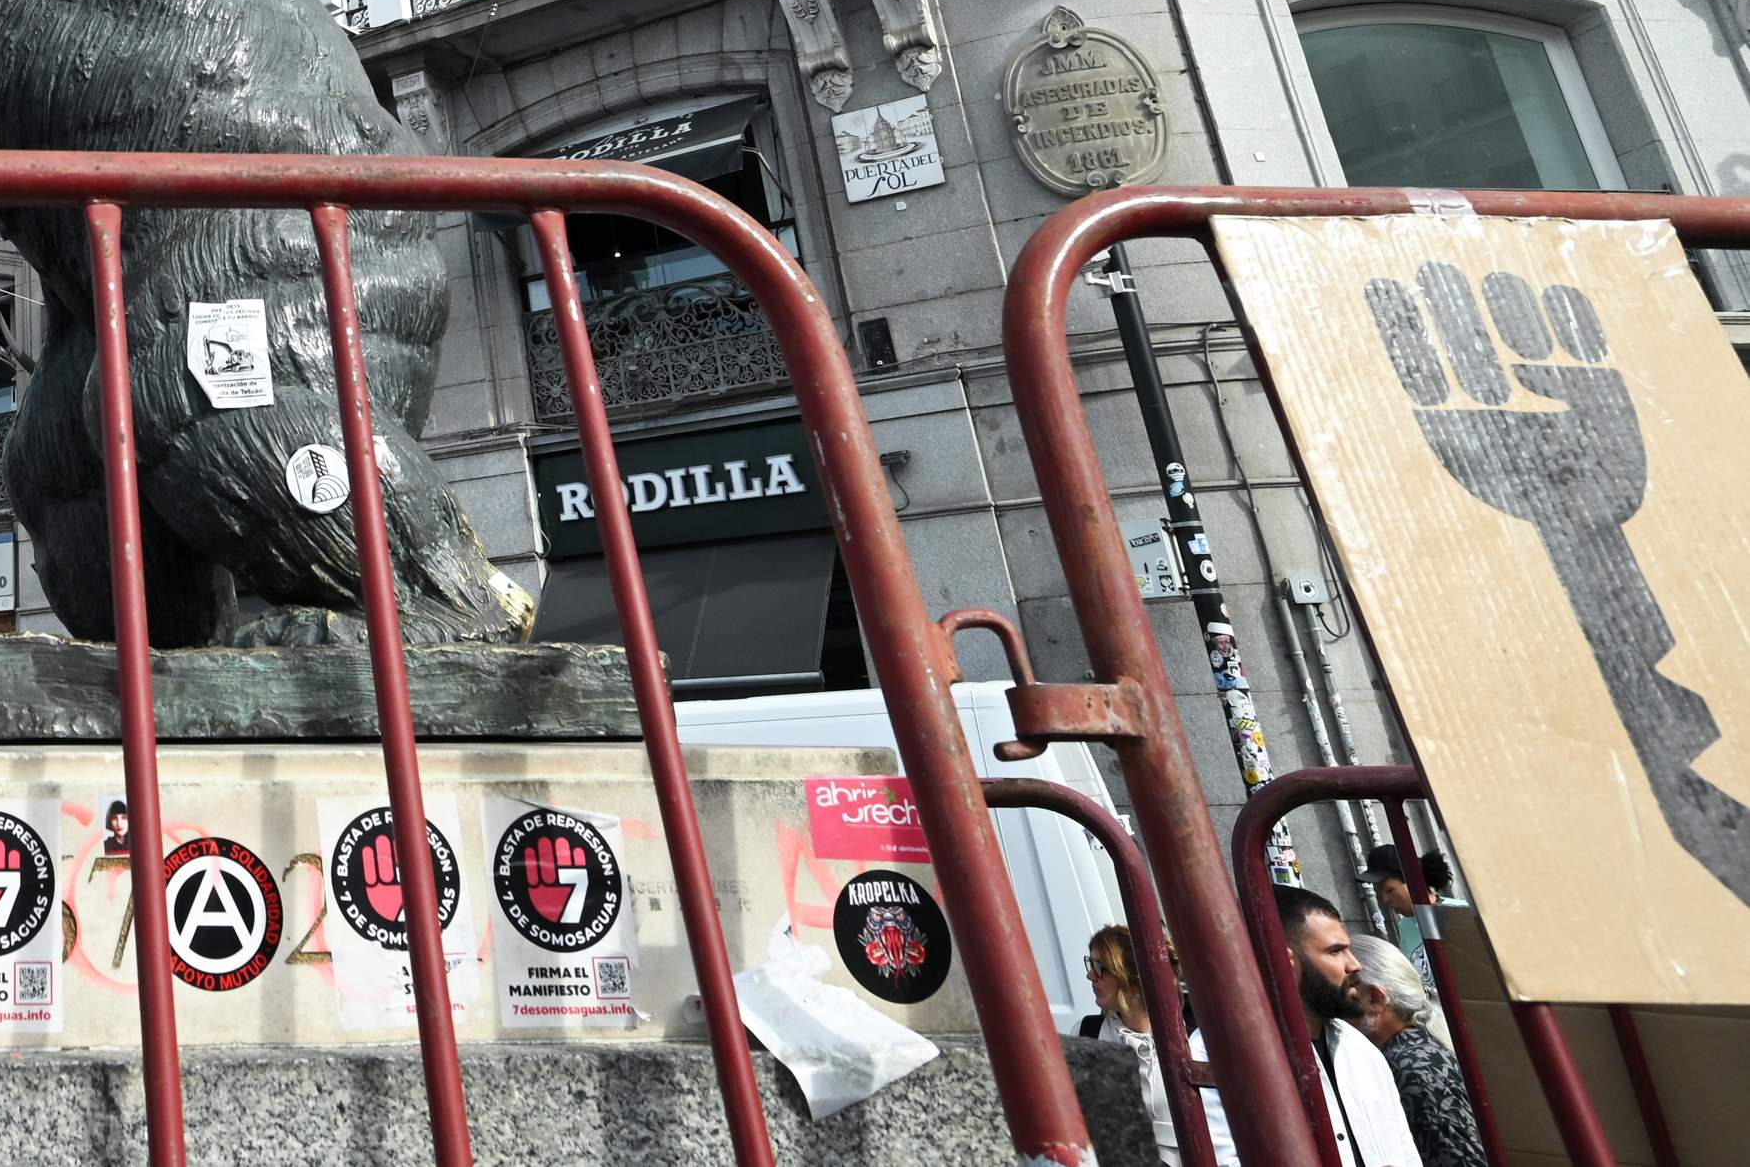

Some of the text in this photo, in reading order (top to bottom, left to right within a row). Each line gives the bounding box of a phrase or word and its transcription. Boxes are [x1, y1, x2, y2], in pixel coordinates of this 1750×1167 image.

[1021, 77, 1142, 108] ASEGURADAS
[1062, 101, 1109, 120] DE
[844, 154, 937, 182] PUERTA DEL
[1066, 146, 1130, 174] 1861
[867, 172, 917, 197] SOL
[842, 798, 922, 826] brech
[337, 827, 363, 877] BASTA
[361, 812, 382, 831] DE
[499, 813, 615, 877] BASTA DE REPRESIÓN
[848, 880, 921, 906] KROPELKA
[164, 840, 279, 990] DIRECTA SOLIDARIDAD APOYO MUTUO
[346, 903, 368, 929] DE
[509, 904, 531, 929] DE
[529, 891, 618, 947] SOMOSAGUAS
[528, 966, 589, 980] FIRMA EL
[509, 984, 591, 998] MANIFIESTO
[512, 1004, 636, 1018] 7desomosaguas.info
